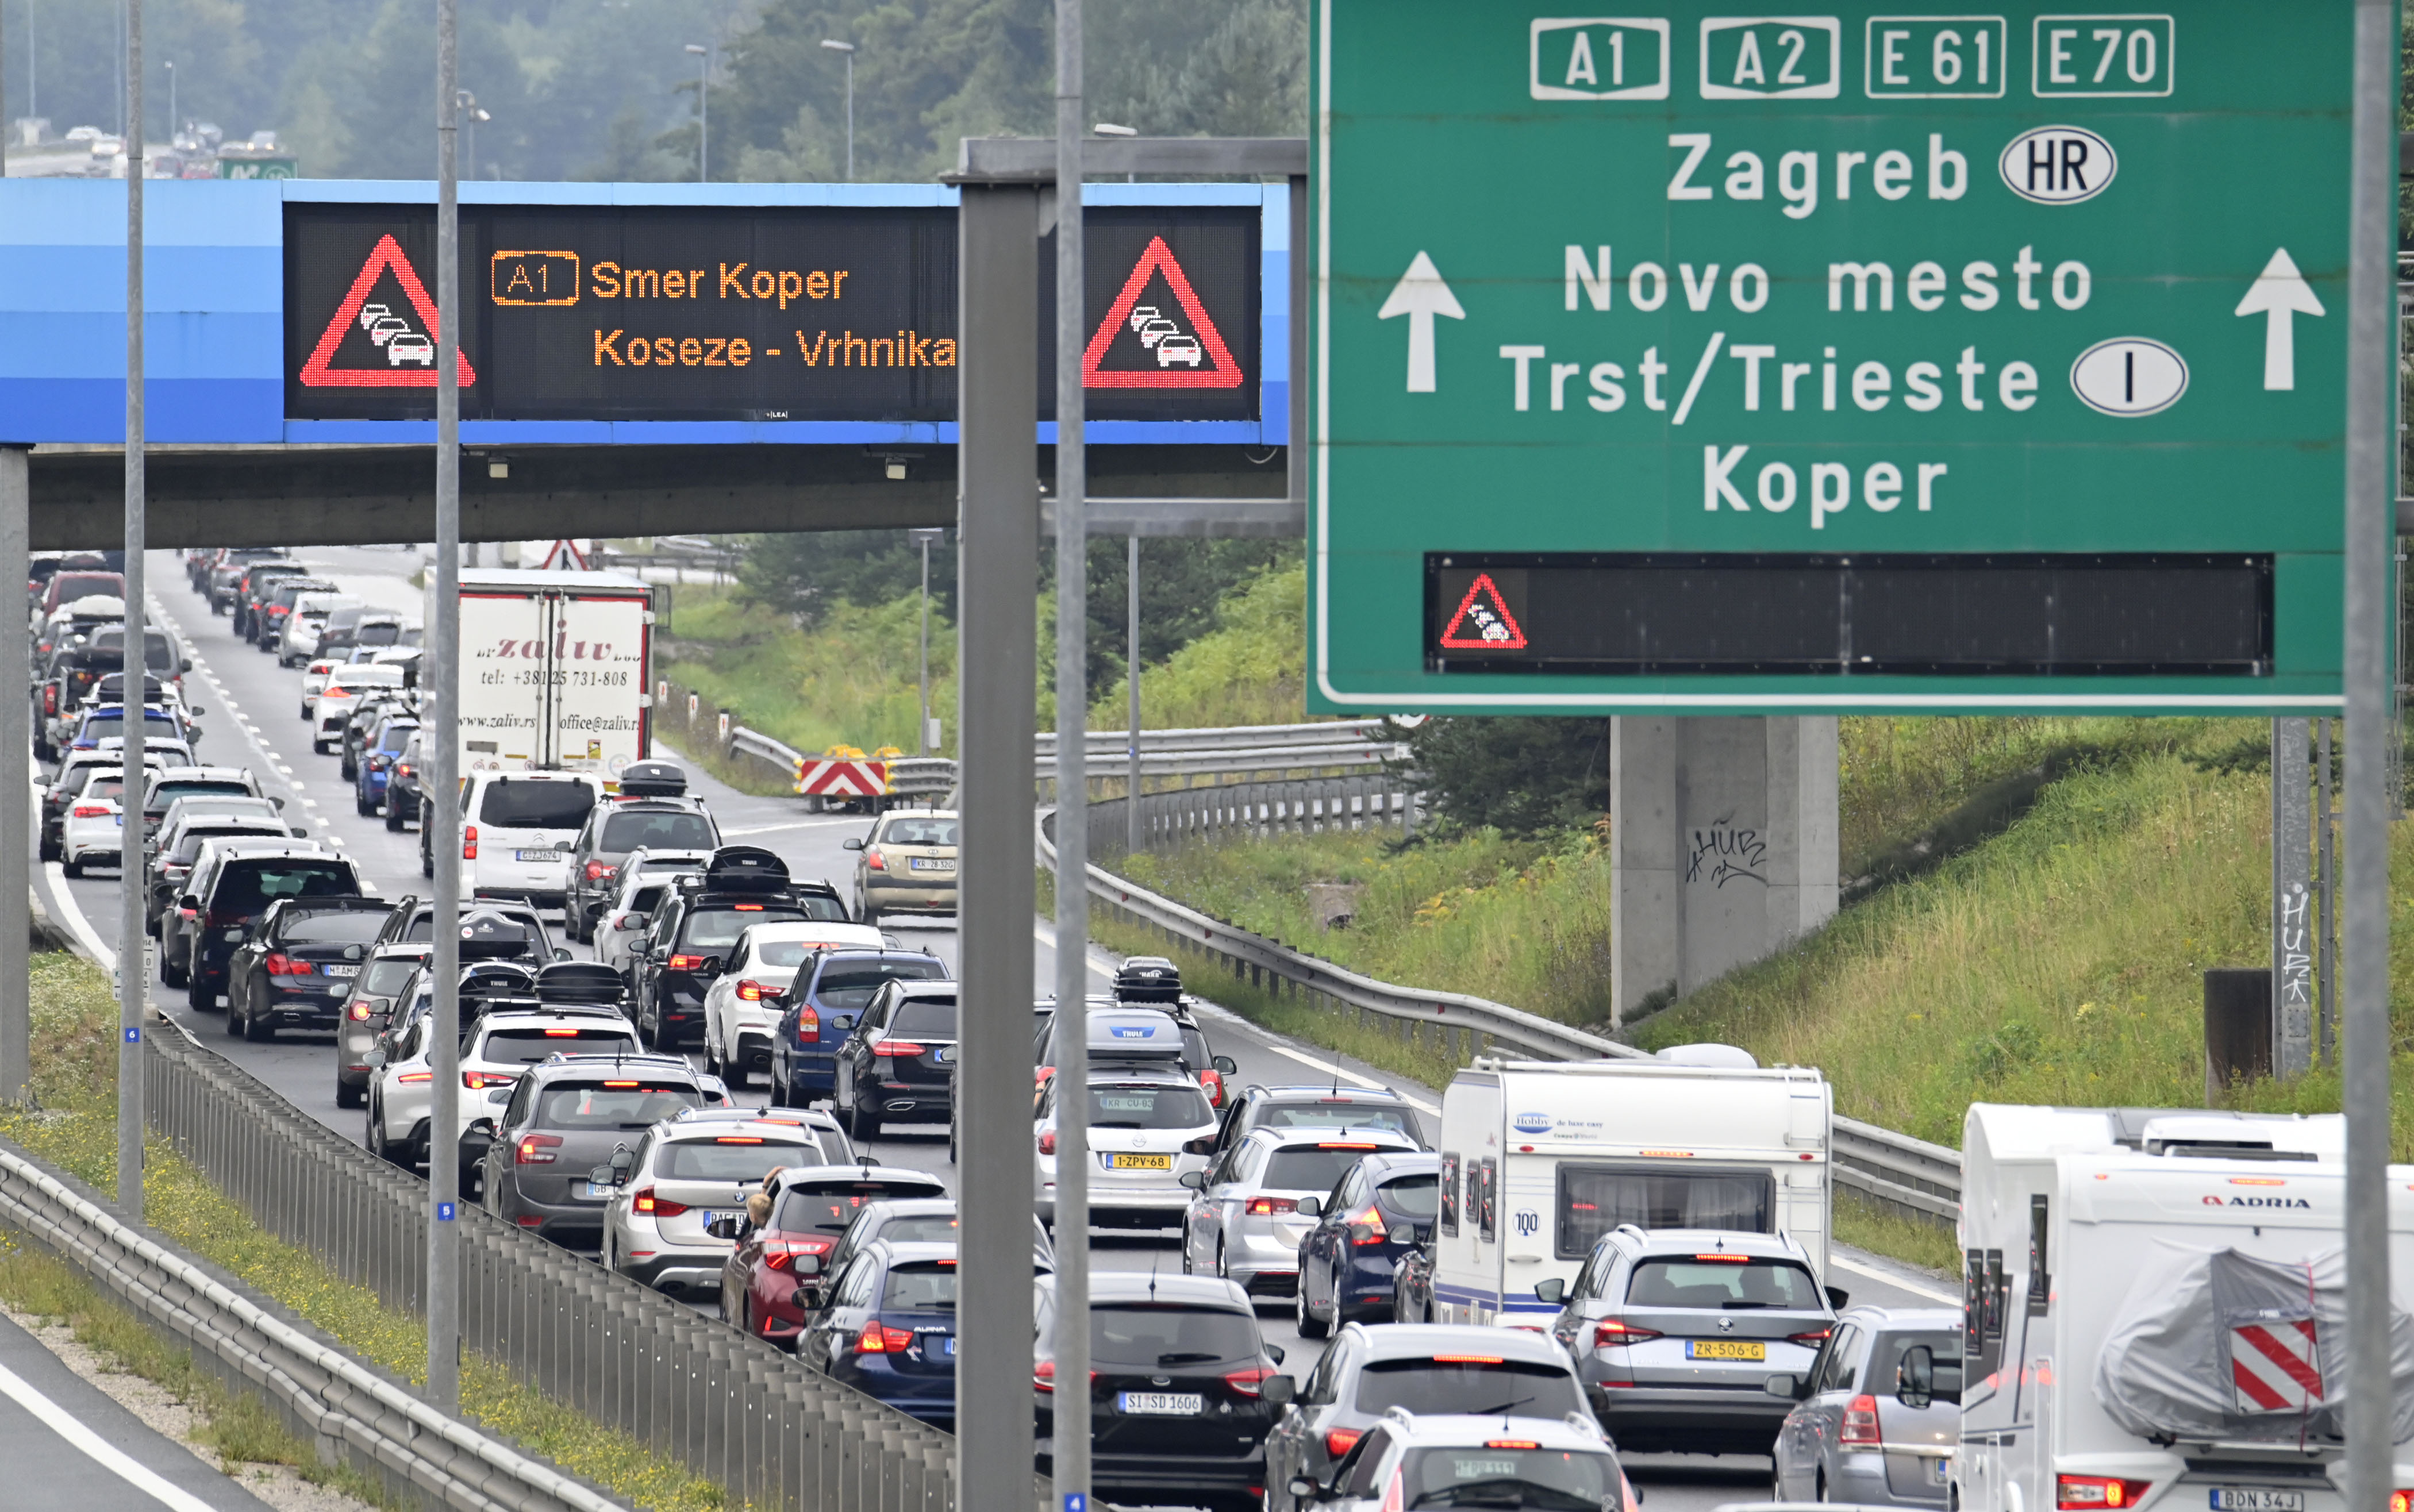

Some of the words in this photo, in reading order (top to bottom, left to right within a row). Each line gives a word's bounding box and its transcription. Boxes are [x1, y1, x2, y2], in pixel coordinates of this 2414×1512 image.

[1566, 31, 1624, 84] A1
[1734, 30, 1805, 84] A2
[1883, 31, 1909, 84] E
[1933, 30, 1988, 84] 61
[2051, 30, 2077, 83] E
[2092, 30, 2155, 82] 70
[1667, 134, 1967, 218] Zagreb
[2027, 140, 2088, 191] HR
[508, 264, 547, 292] A1
[592, 261, 704, 298] Smer
[720, 263, 848, 309] Koper
[1566, 245, 1768, 312] Novo
[1829, 246, 2090, 311] mesto
[595, 330, 751, 366] Koseze
[796, 330, 955, 366] Vrhnika
[1500, 333, 2037, 424] Trst/Trieste
[1705, 445, 1947, 529] Koper
[574, 671, 627, 686] 731-808
[129, 1030, 135, 1038] 6
[1517, 1117, 1550, 1126] Hobby
[1118, 1156, 1164, 1167] 1-ZPV-68
[443, 1206, 450, 1216] 5
[1516, 1213, 1538, 1232] 100
[2229, 1196, 2312, 1209] ADRIA
[1696, 1343, 1759, 1357] ZR-506-G
[1129, 1395, 1141, 1407] SI
[1151, 1396, 1166, 1408] SD
[1170, 1397, 1198, 1409] 1606
